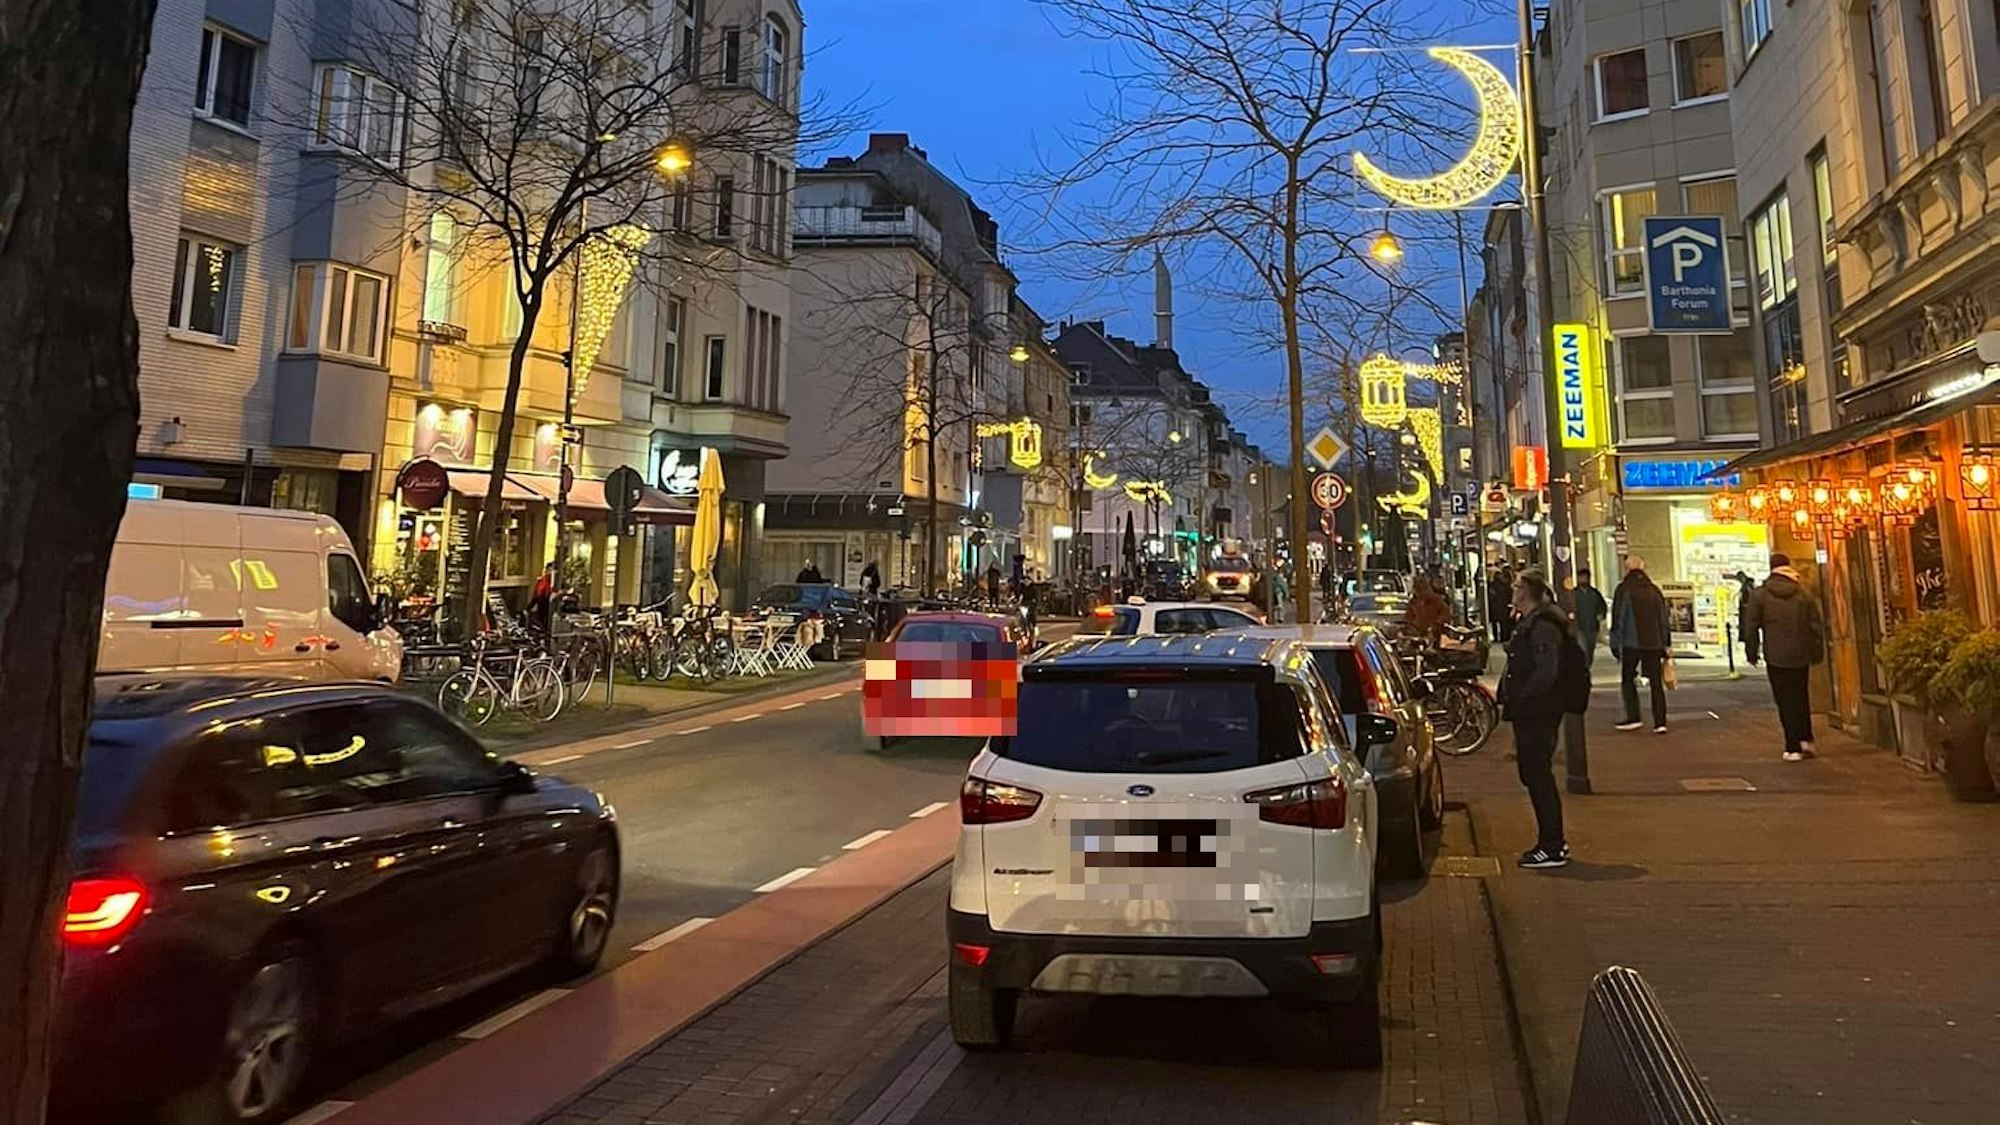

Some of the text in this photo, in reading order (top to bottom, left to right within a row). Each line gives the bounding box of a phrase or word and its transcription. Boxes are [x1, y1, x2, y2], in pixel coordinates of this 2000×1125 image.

[1672, 242, 1703, 282] P
[1661, 285, 1717, 295] Barthonia
[1671, 298, 1708, 308] Forum
[1561, 333, 1585, 439] ZEEMAN
[1320, 483, 1339, 499] 30
